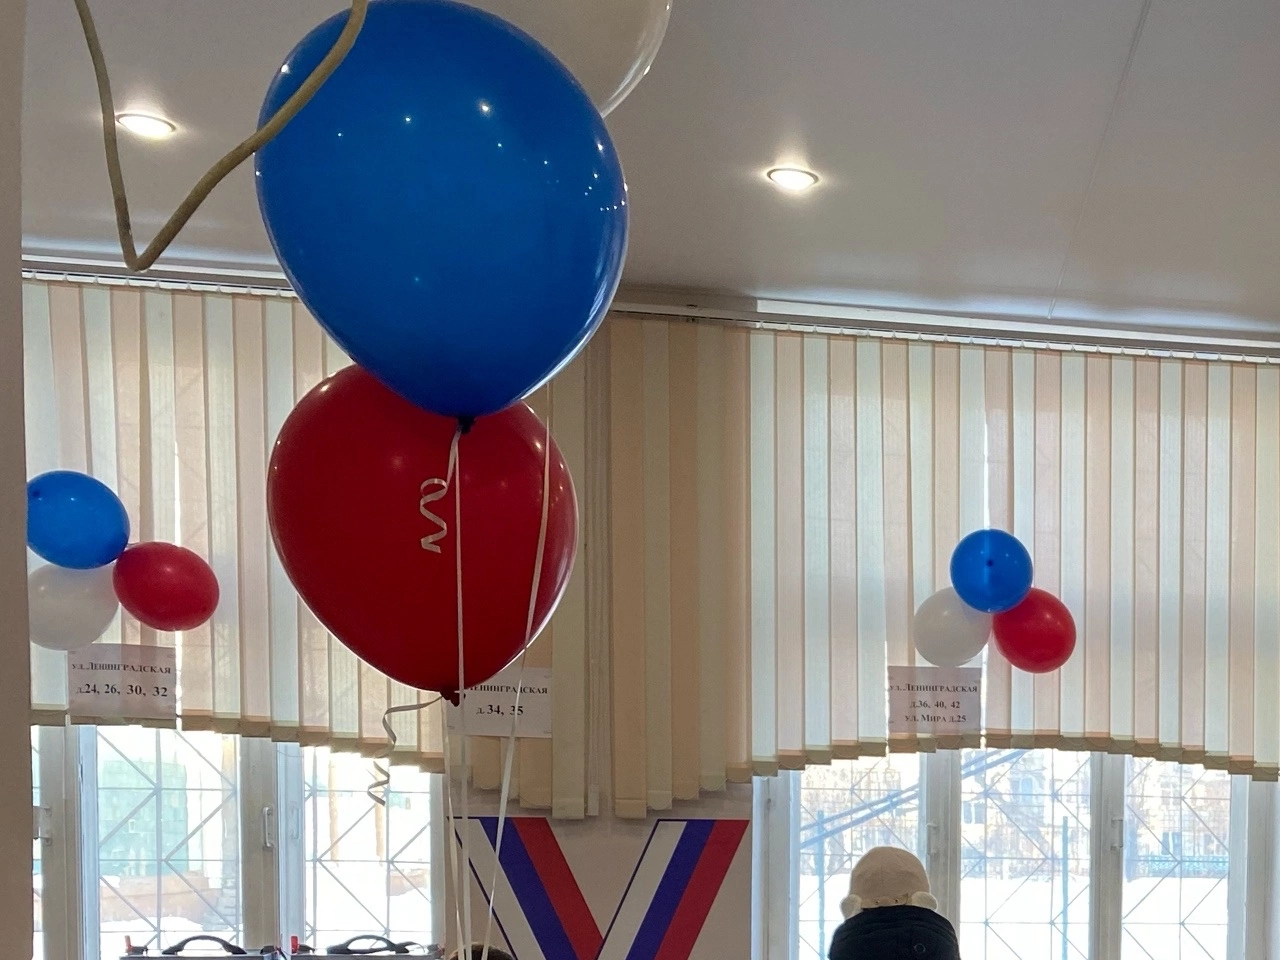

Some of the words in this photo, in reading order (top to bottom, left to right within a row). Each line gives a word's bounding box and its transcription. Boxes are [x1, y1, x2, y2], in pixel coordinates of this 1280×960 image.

[104, 684, 121, 695] 26,
[127, 685, 146, 697] 30,
[152, 687, 168, 697] 32
[950, 701, 961, 709] 42
[510, 706, 524, 716] 35
